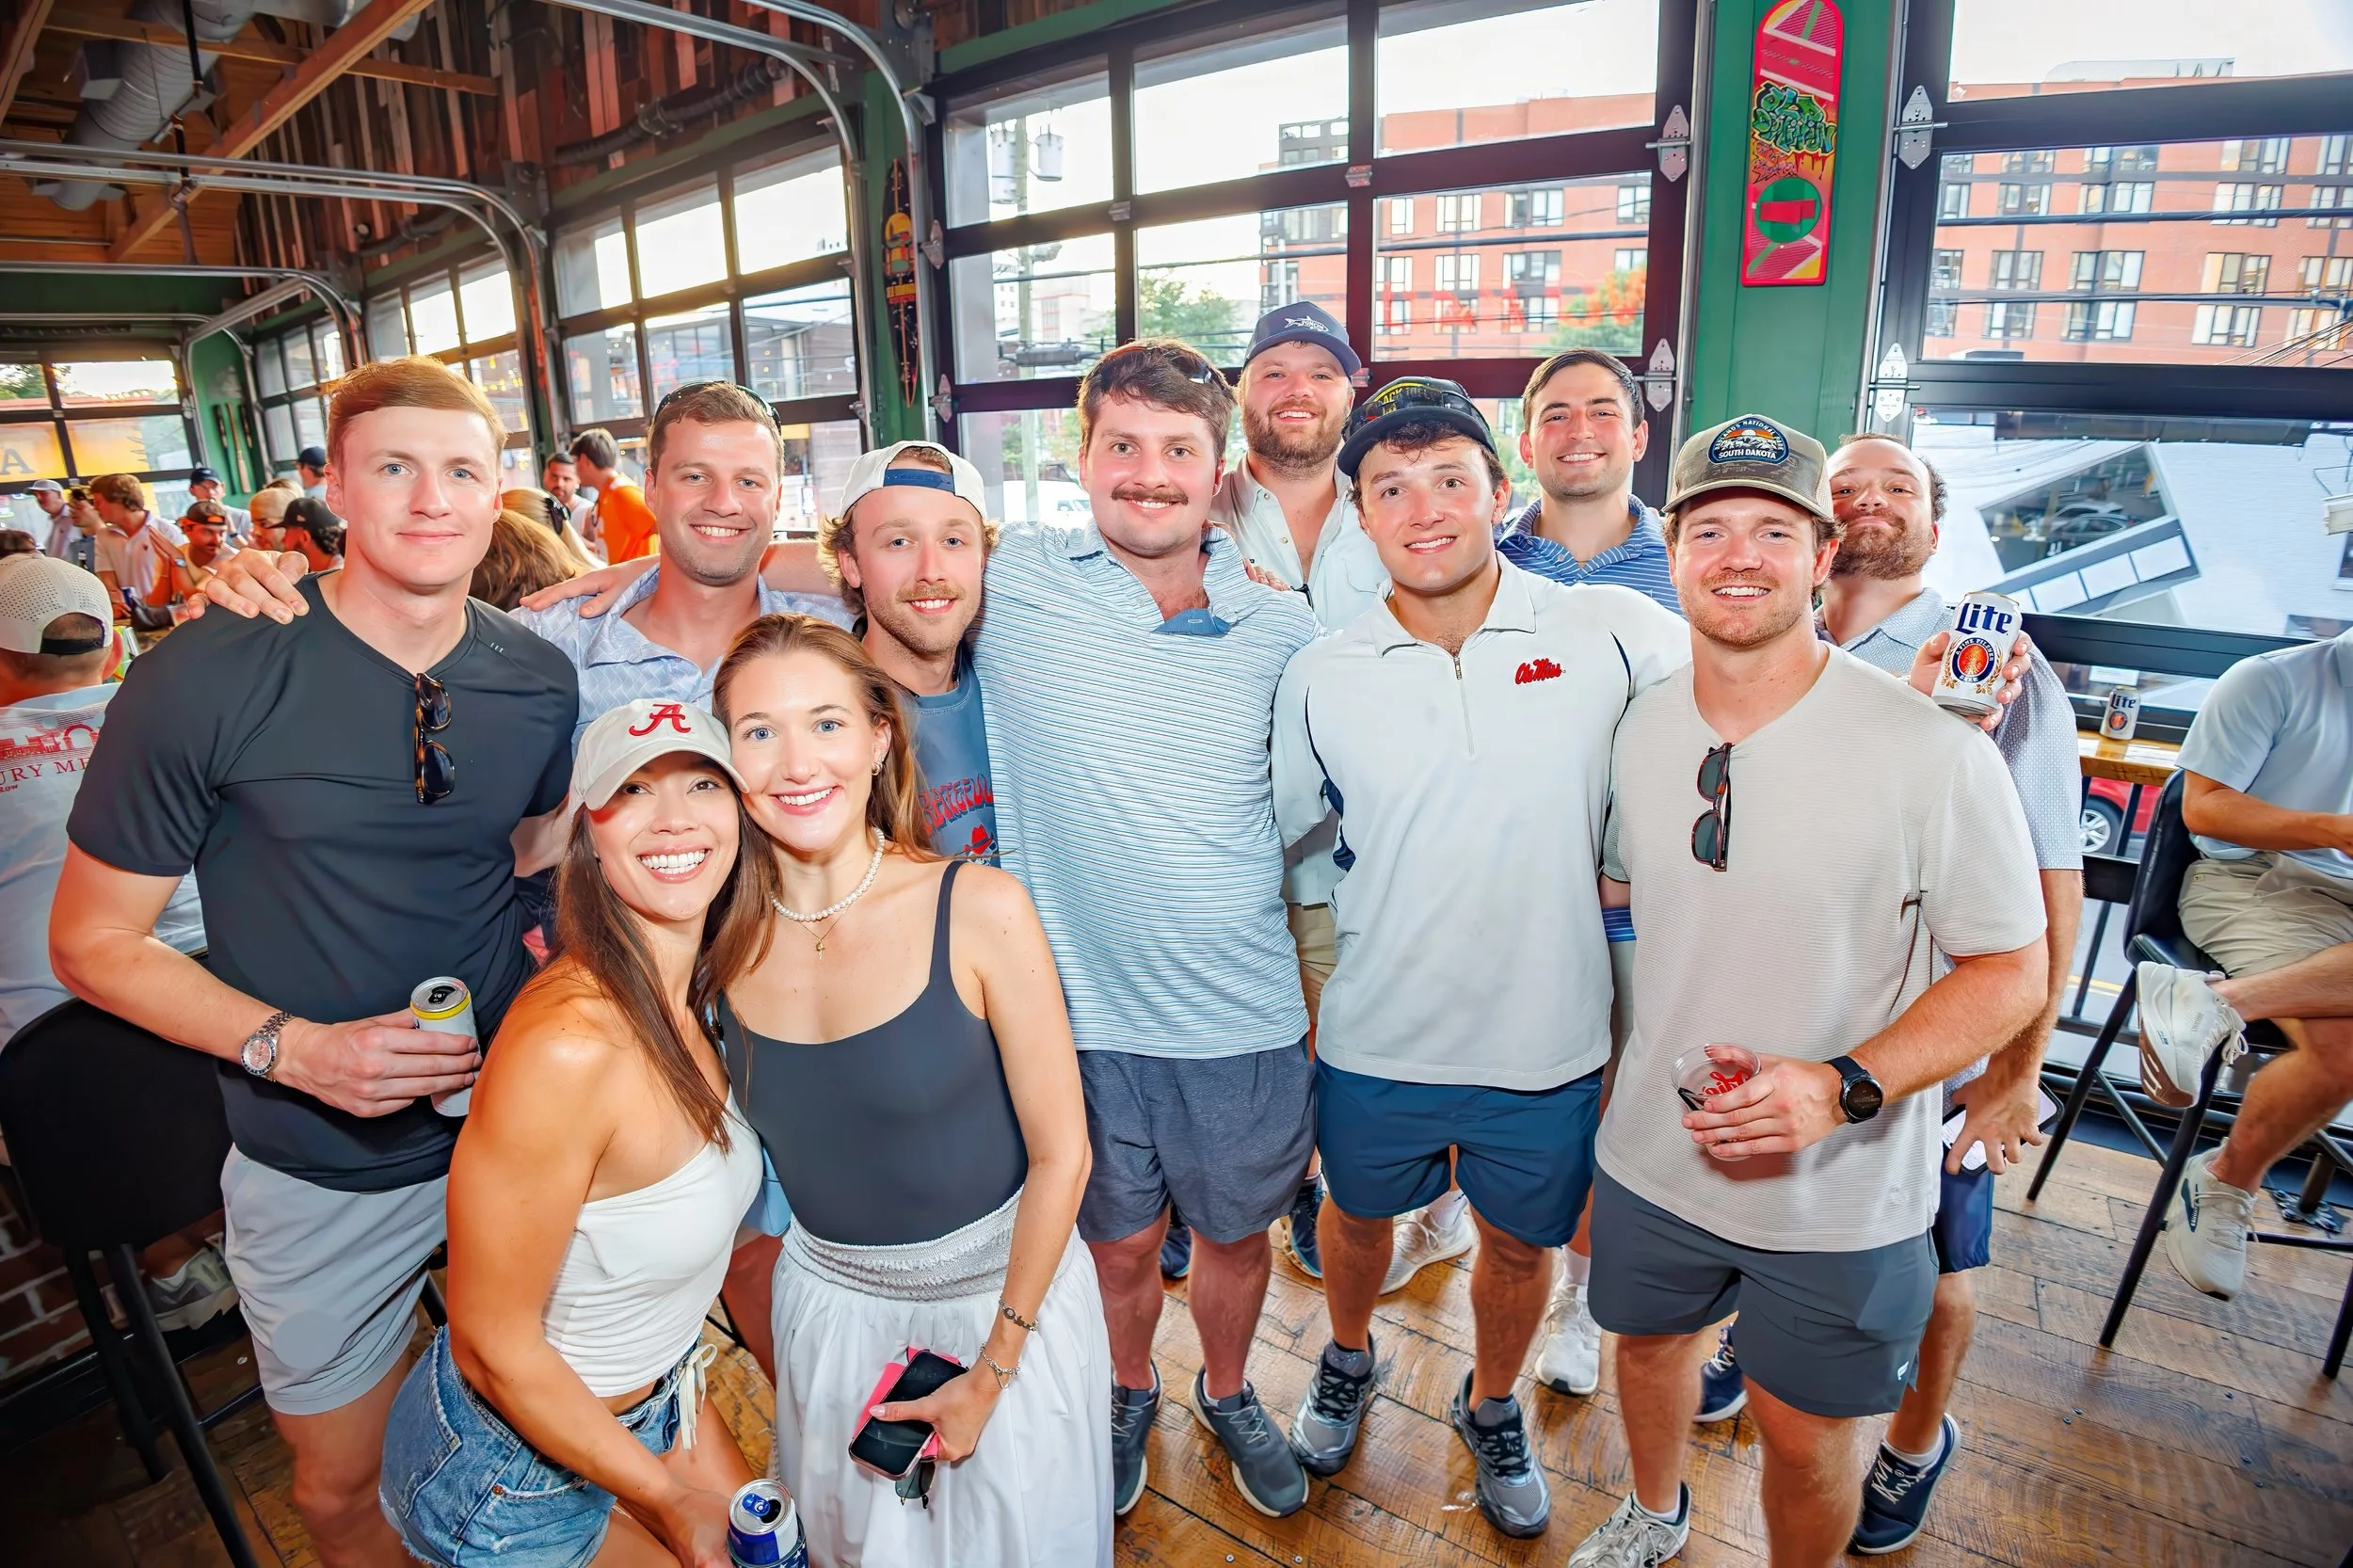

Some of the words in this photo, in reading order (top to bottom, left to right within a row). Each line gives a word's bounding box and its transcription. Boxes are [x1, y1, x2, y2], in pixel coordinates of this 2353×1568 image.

[1743, 420, 1775, 435] NATIONAL
[1719, 449, 1744, 459] SOUTH
[1745, 449, 1776, 459] DAKOTA
[1955, 602, 2013, 635] Lite
[2110, 694, 2137, 709] Lite
[628, 703, 692, 737] A
[918, 773, 994, 838] RATEFUL
